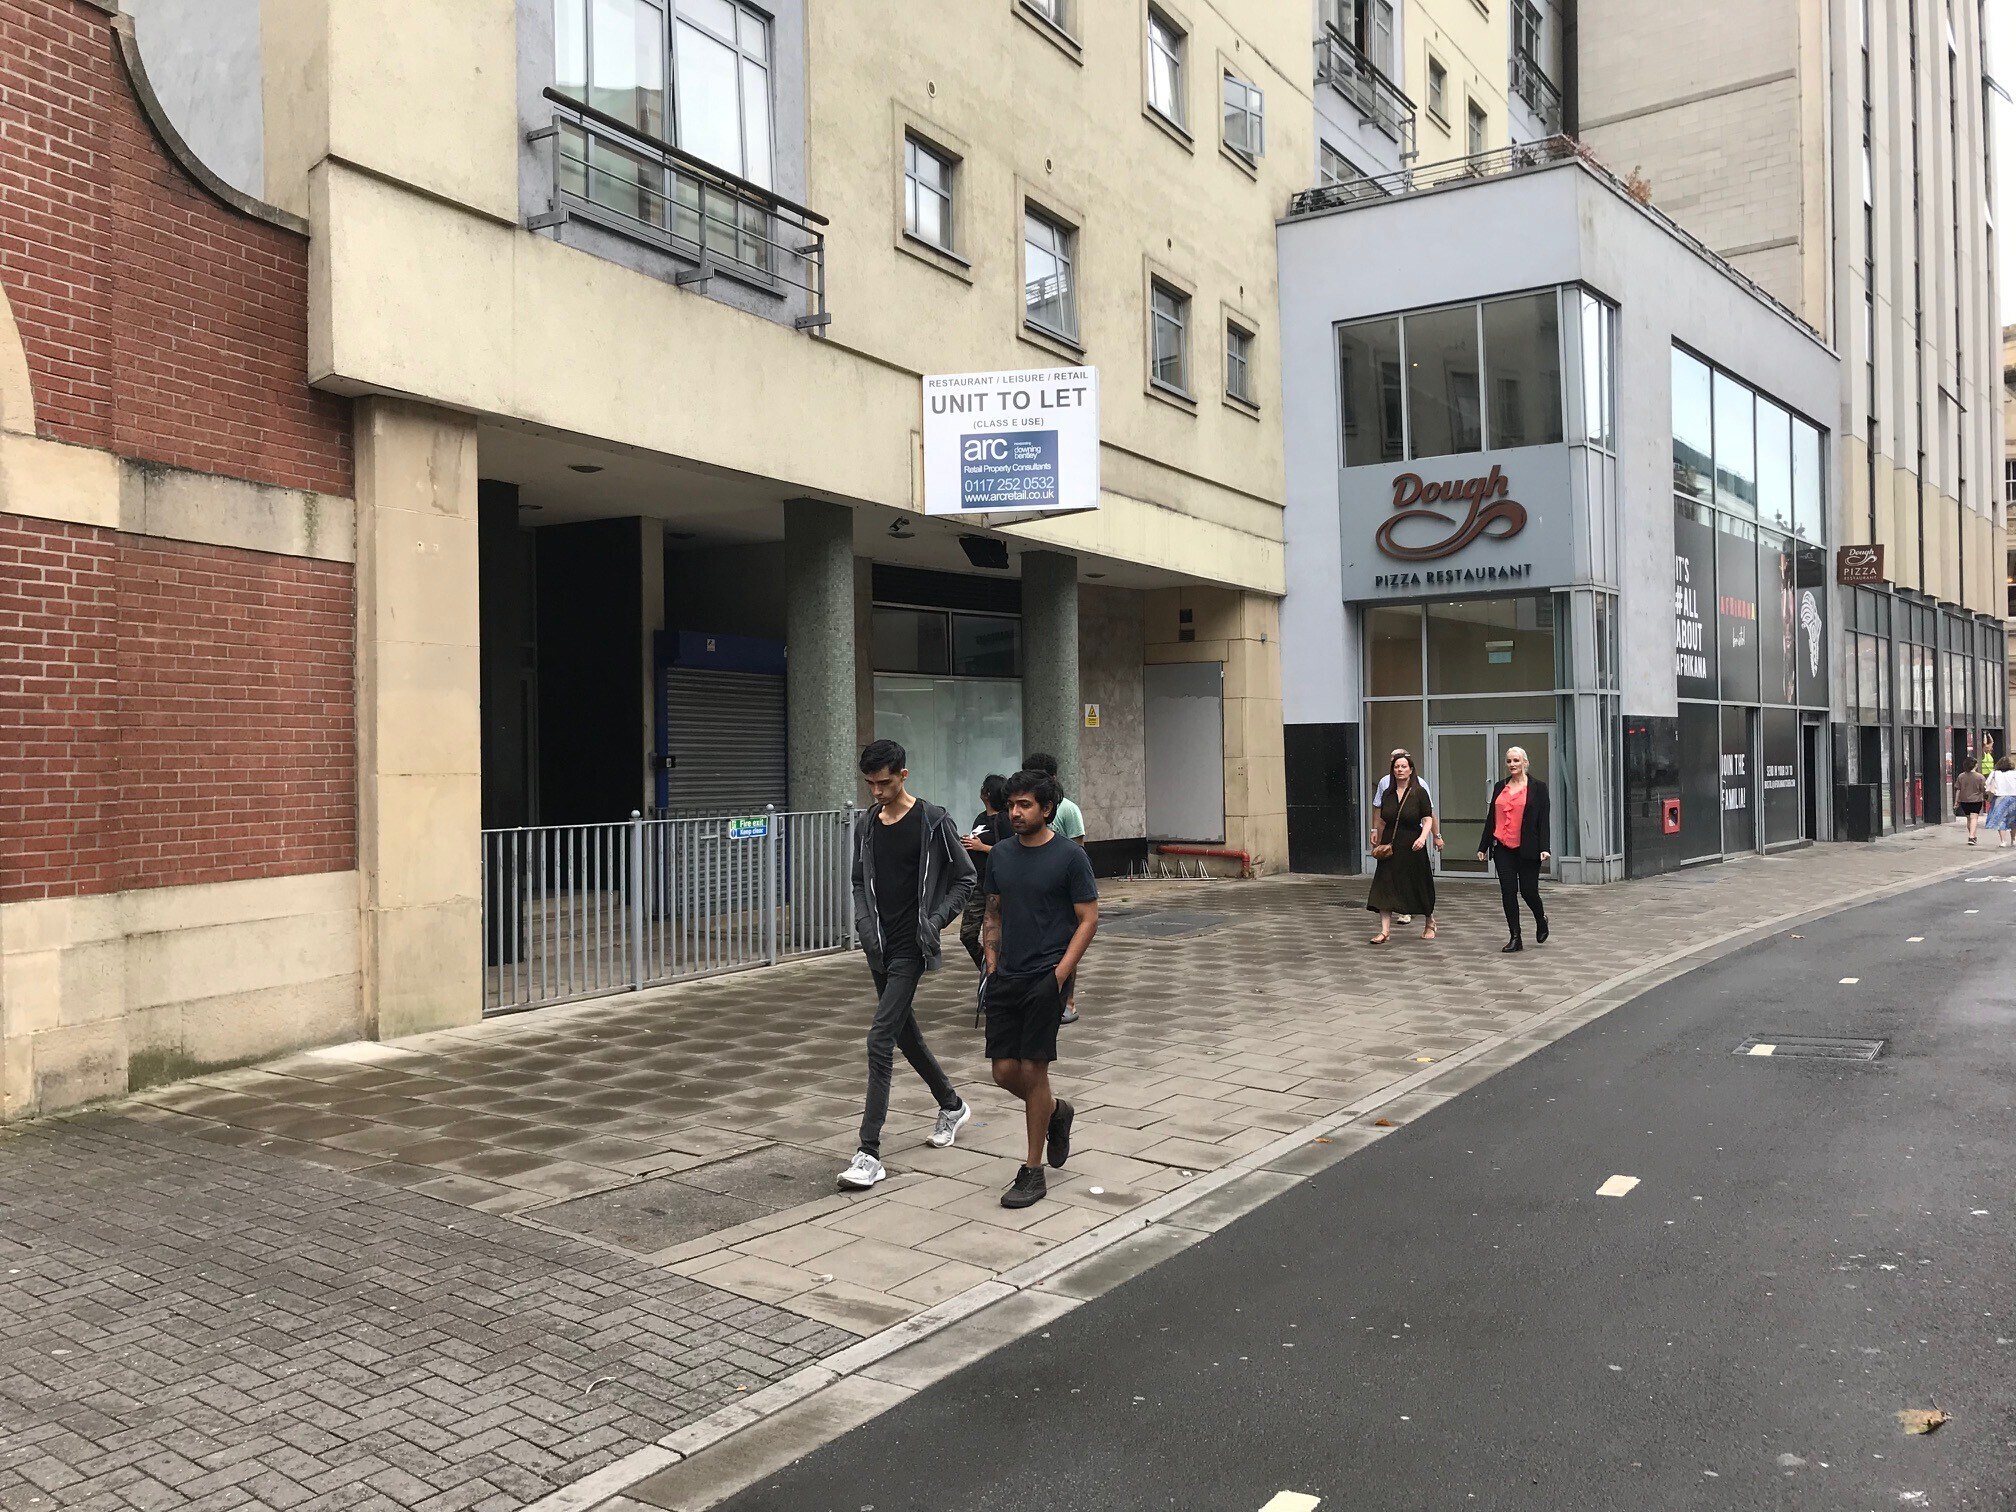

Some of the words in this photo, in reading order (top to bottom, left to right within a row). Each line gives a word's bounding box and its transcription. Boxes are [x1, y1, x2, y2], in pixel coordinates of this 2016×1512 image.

[929, 376, 993, 387] RESTAURANT
[1003, 374, 1044, 383] LEISURE
[1053, 371, 1088, 381] RETAIL
[931, 392, 988, 414] UNIT
[997, 390, 1031, 411] TO
[1040, 387, 1087, 409] LET
[973, 419, 1008, 429] (CLASS
[1012, 418, 1018, 427] E
[1021, 417, 1044, 427] USE)
[964, 438, 1008, 461] arc
[1014, 446, 1041, 454] downing
[964, 465, 982, 473] Retail
[983, 464, 1011, 473] Property
[1012, 462, 1052, 471] Consultants
[964, 479, 994, 492] 0117
[997, 478, 1021, 491] 252
[1023, 476, 1054, 490] 0532
[964, 489, 1055, 502] www.arcretail.co.uk
[1375, 572, 1421, 587] PIZZA
[1426, 563, 1532, 584] RESTAURANT
[1843, 567, 1877, 576] PIZZA
[1675, 585, 1699, 619] #ALL
[1676, 619, 1702, 651] ABOUT
[1676, 653, 1707, 679] AFRIKANA
[740, 820, 751, 828] Fire
